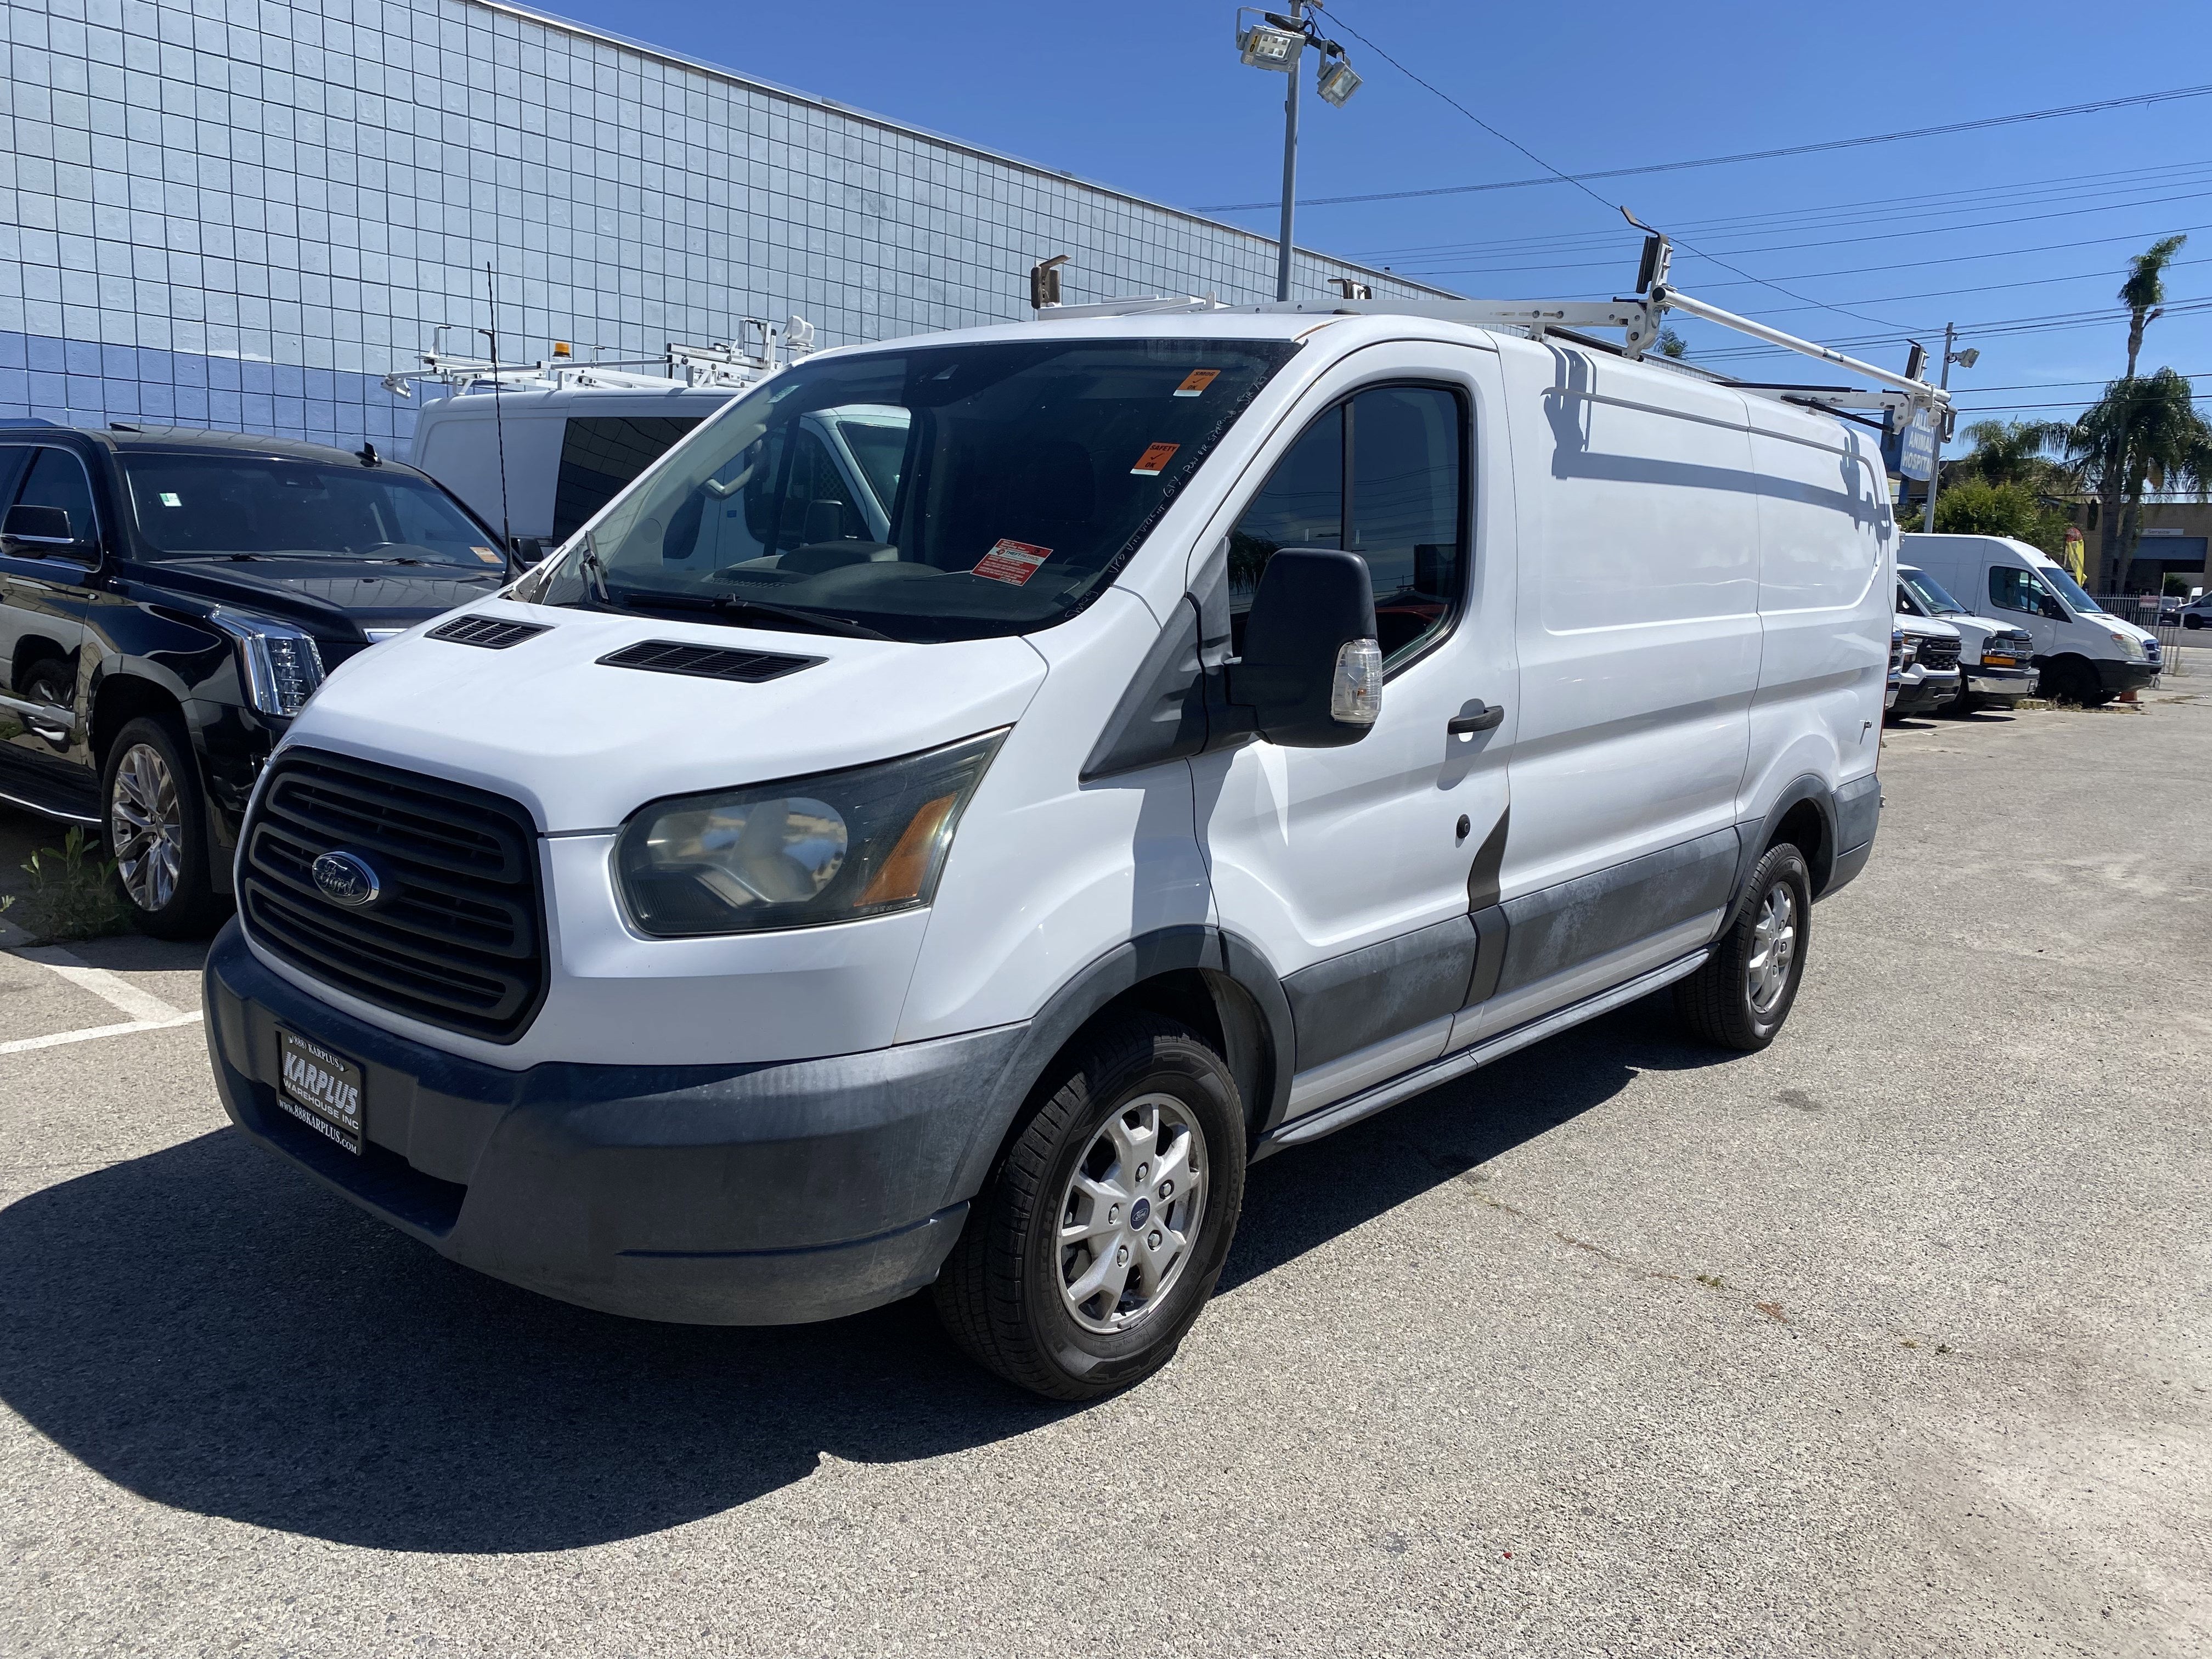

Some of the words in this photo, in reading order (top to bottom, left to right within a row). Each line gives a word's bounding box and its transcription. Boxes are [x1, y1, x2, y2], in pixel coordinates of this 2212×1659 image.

[1909, 431, 1932, 453] ANIMAL
[1903, 450, 1931, 473] HOSPITA
[320, 860, 356, 896] Ford
[308, 1044, 339, 1068] KARPLUS
[284, 1051, 358, 1115] KARPLUS
[283, 1078, 339, 1119] WAREHOUSE
[342, 1114, 359, 1130] INC
